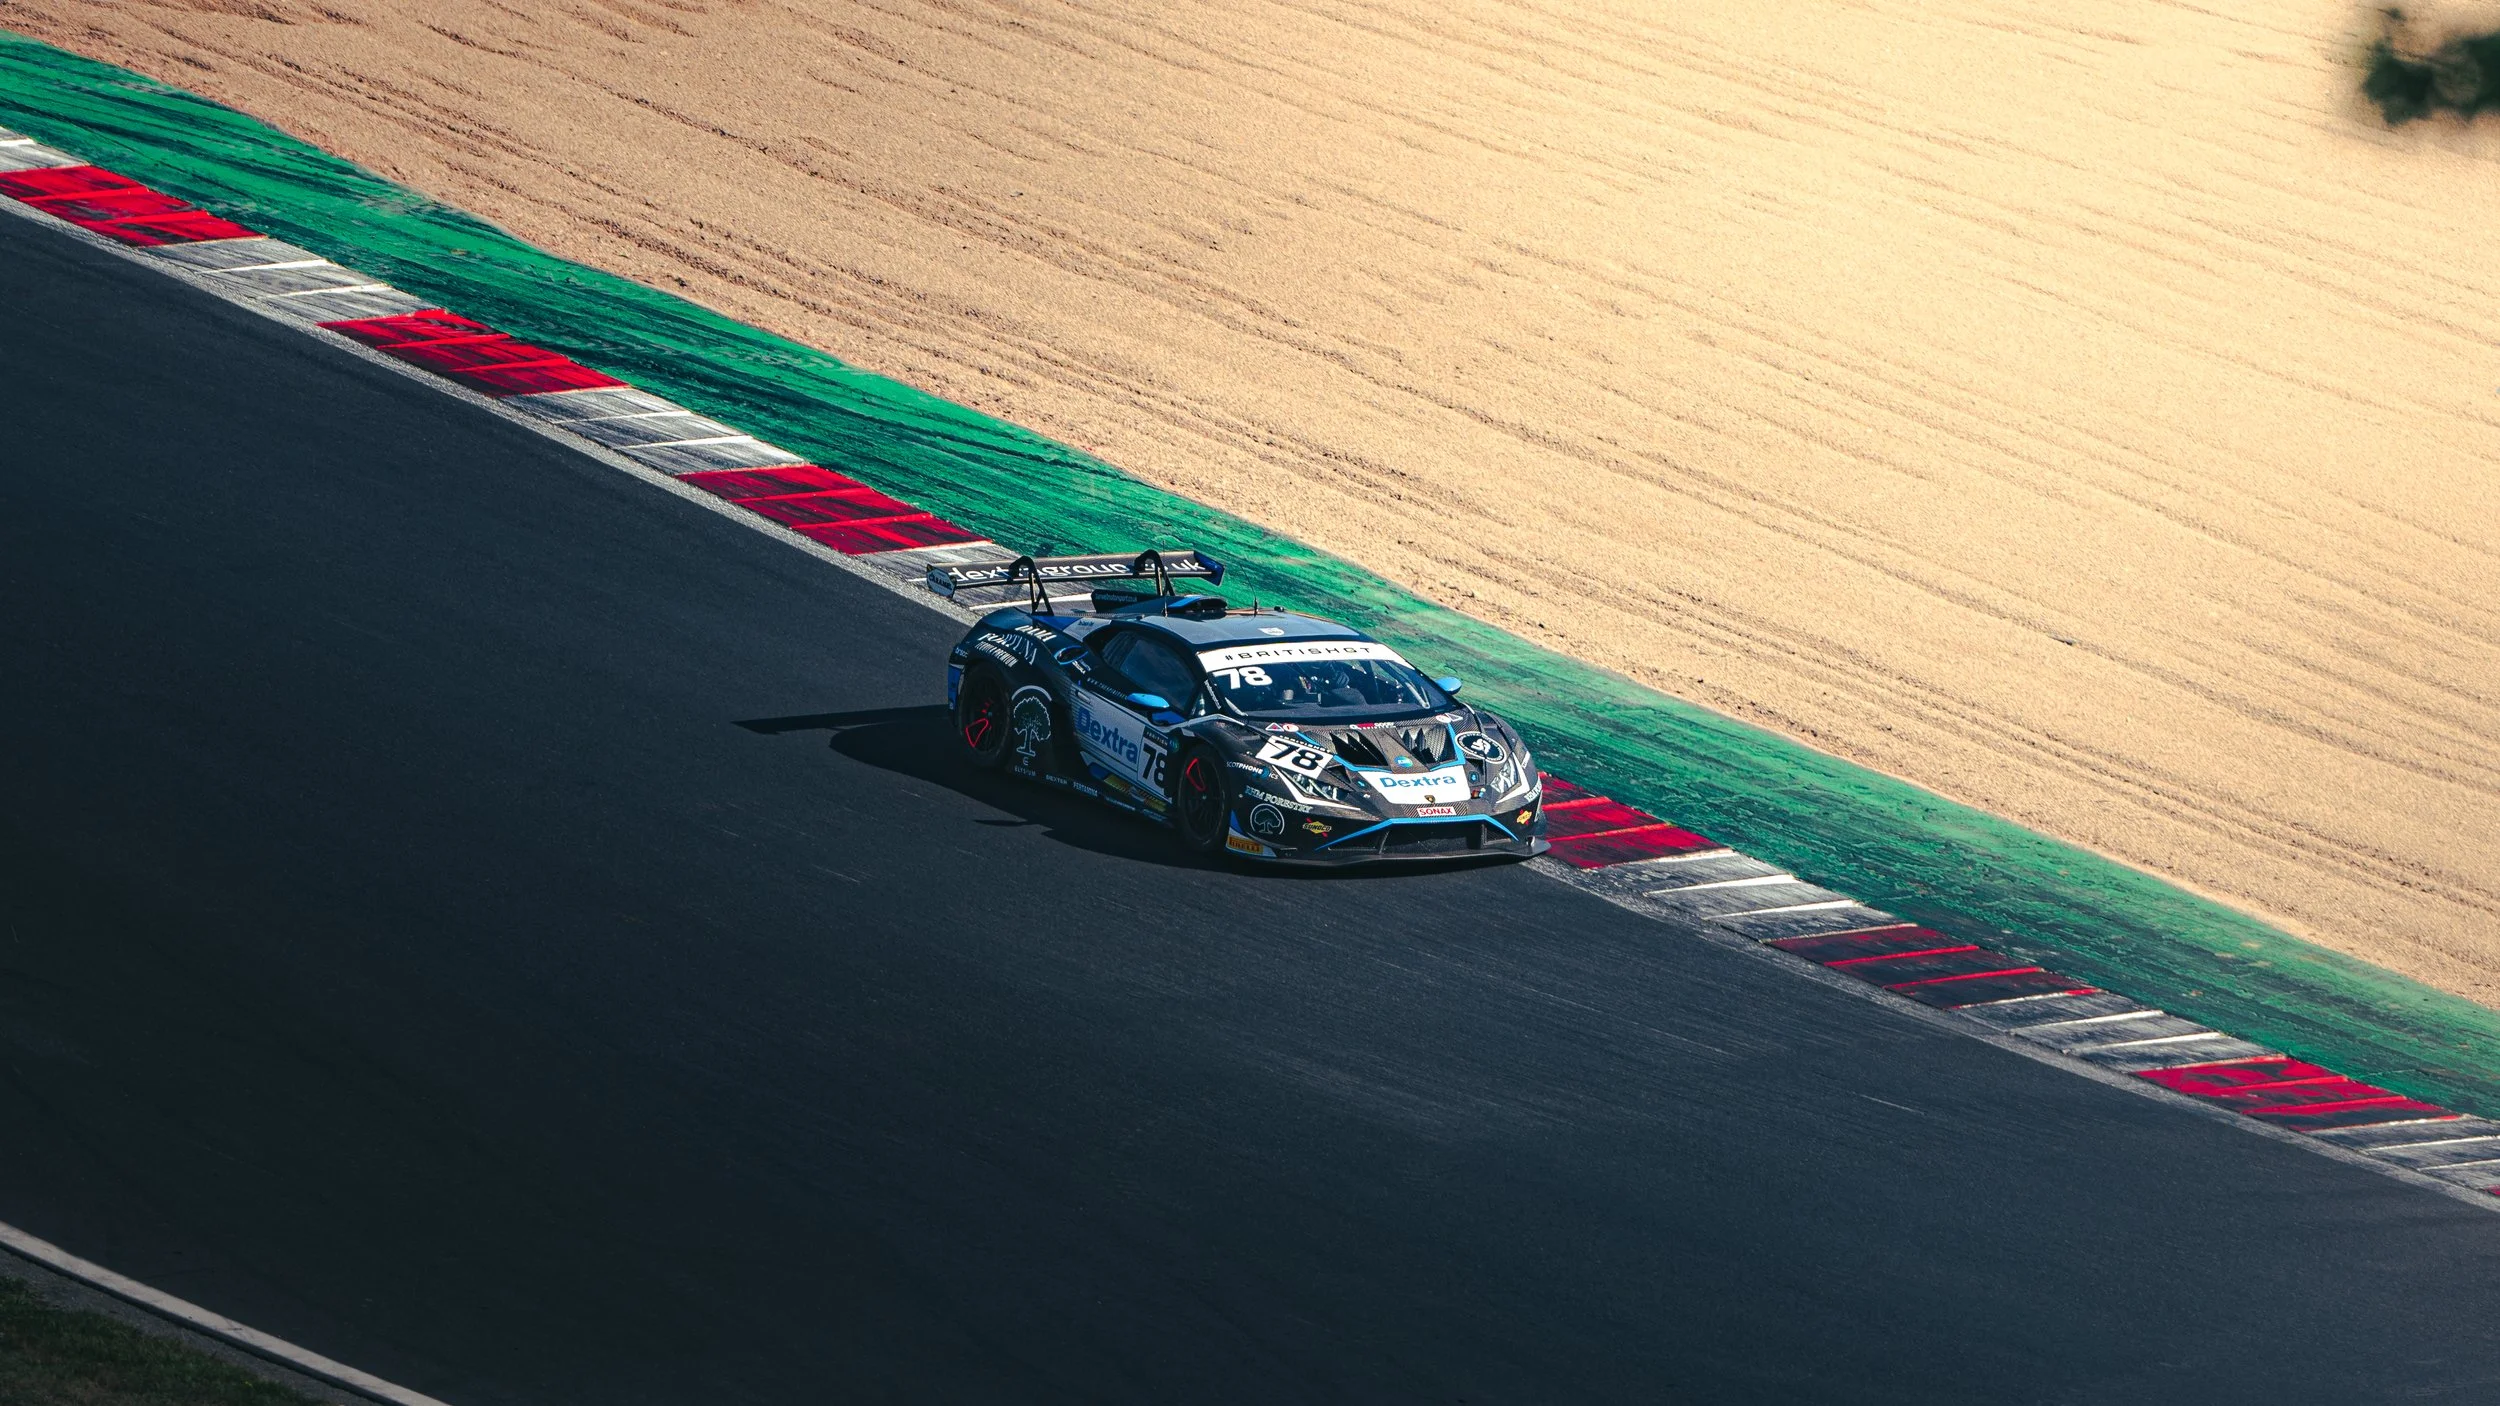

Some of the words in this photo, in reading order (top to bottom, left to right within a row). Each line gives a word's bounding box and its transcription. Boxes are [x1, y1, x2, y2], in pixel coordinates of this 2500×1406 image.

[1212, 665, 1273, 690] 78
[1077, 706, 1139, 765] Dextra
[1141, 743, 1169, 789] 78
[1270, 739, 1324, 771] 78
[1379, 775, 1457, 789] Dextra
[1418, 807, 1453, 817] SONAX
[1303, 822, 1332, 833] SUNOCO
